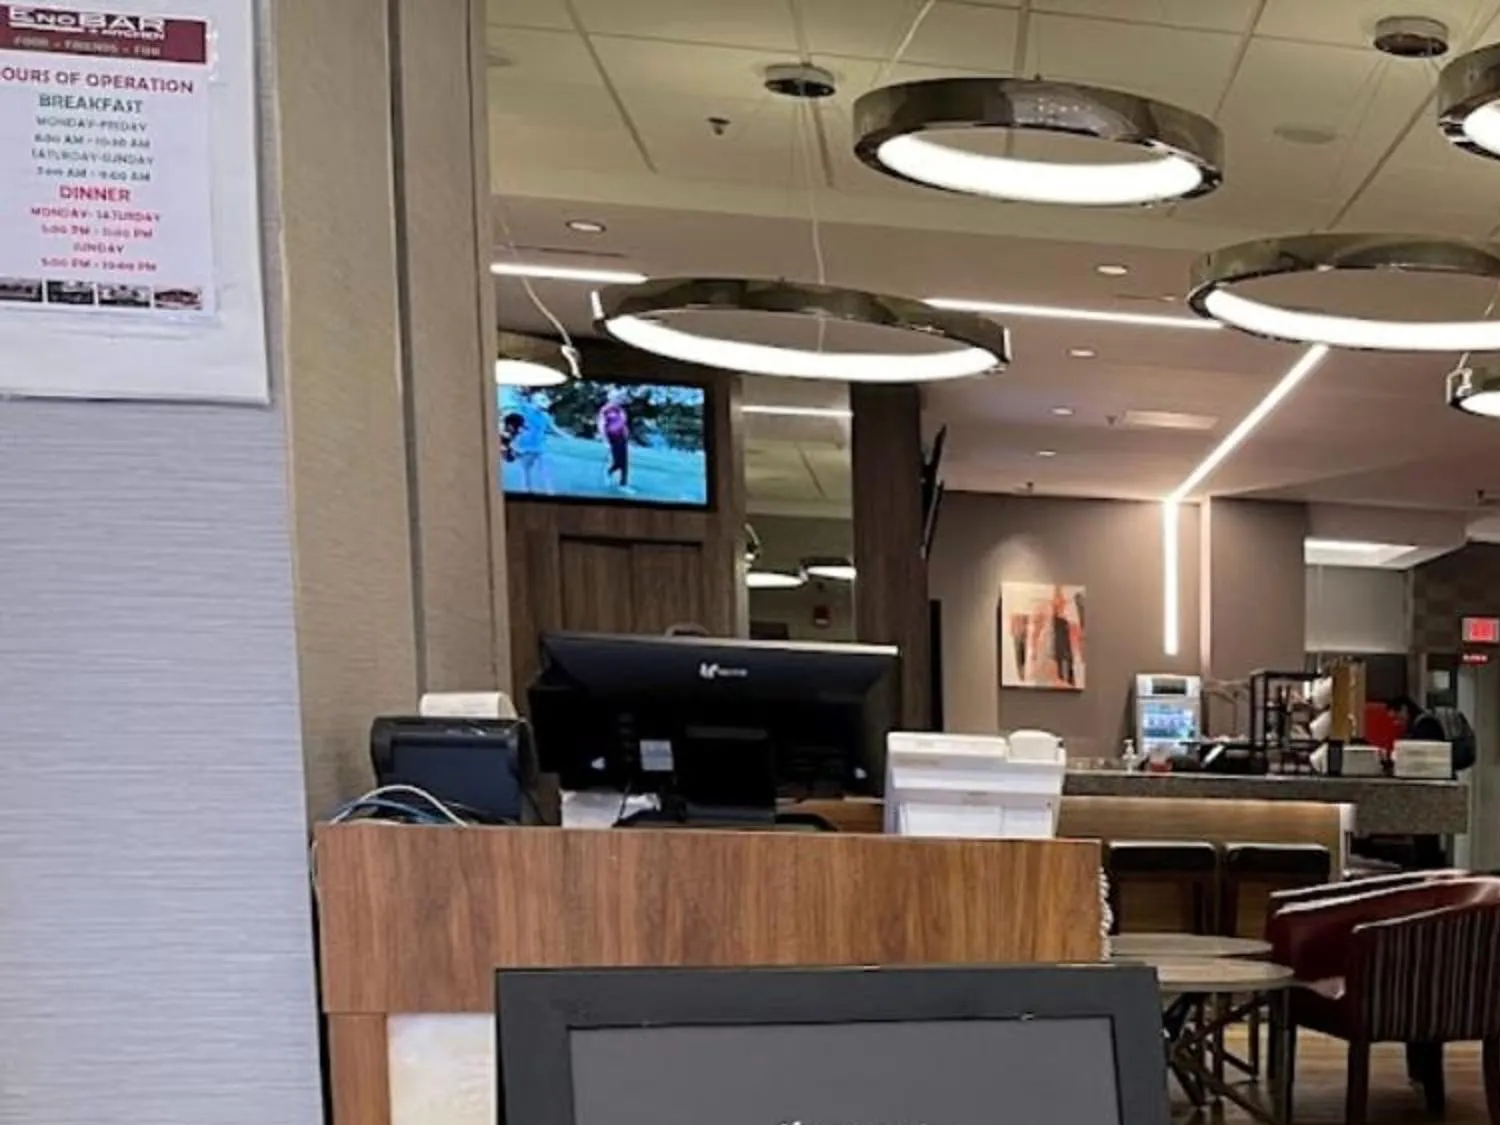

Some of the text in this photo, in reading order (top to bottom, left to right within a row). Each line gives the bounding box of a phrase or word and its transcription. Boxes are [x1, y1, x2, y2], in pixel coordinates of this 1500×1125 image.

[1, 67, 194, 93] OURS OF OPERATION
[38, 94, 143, 112] BREAKFAST
[60, 186, 131, 201] DINNER
